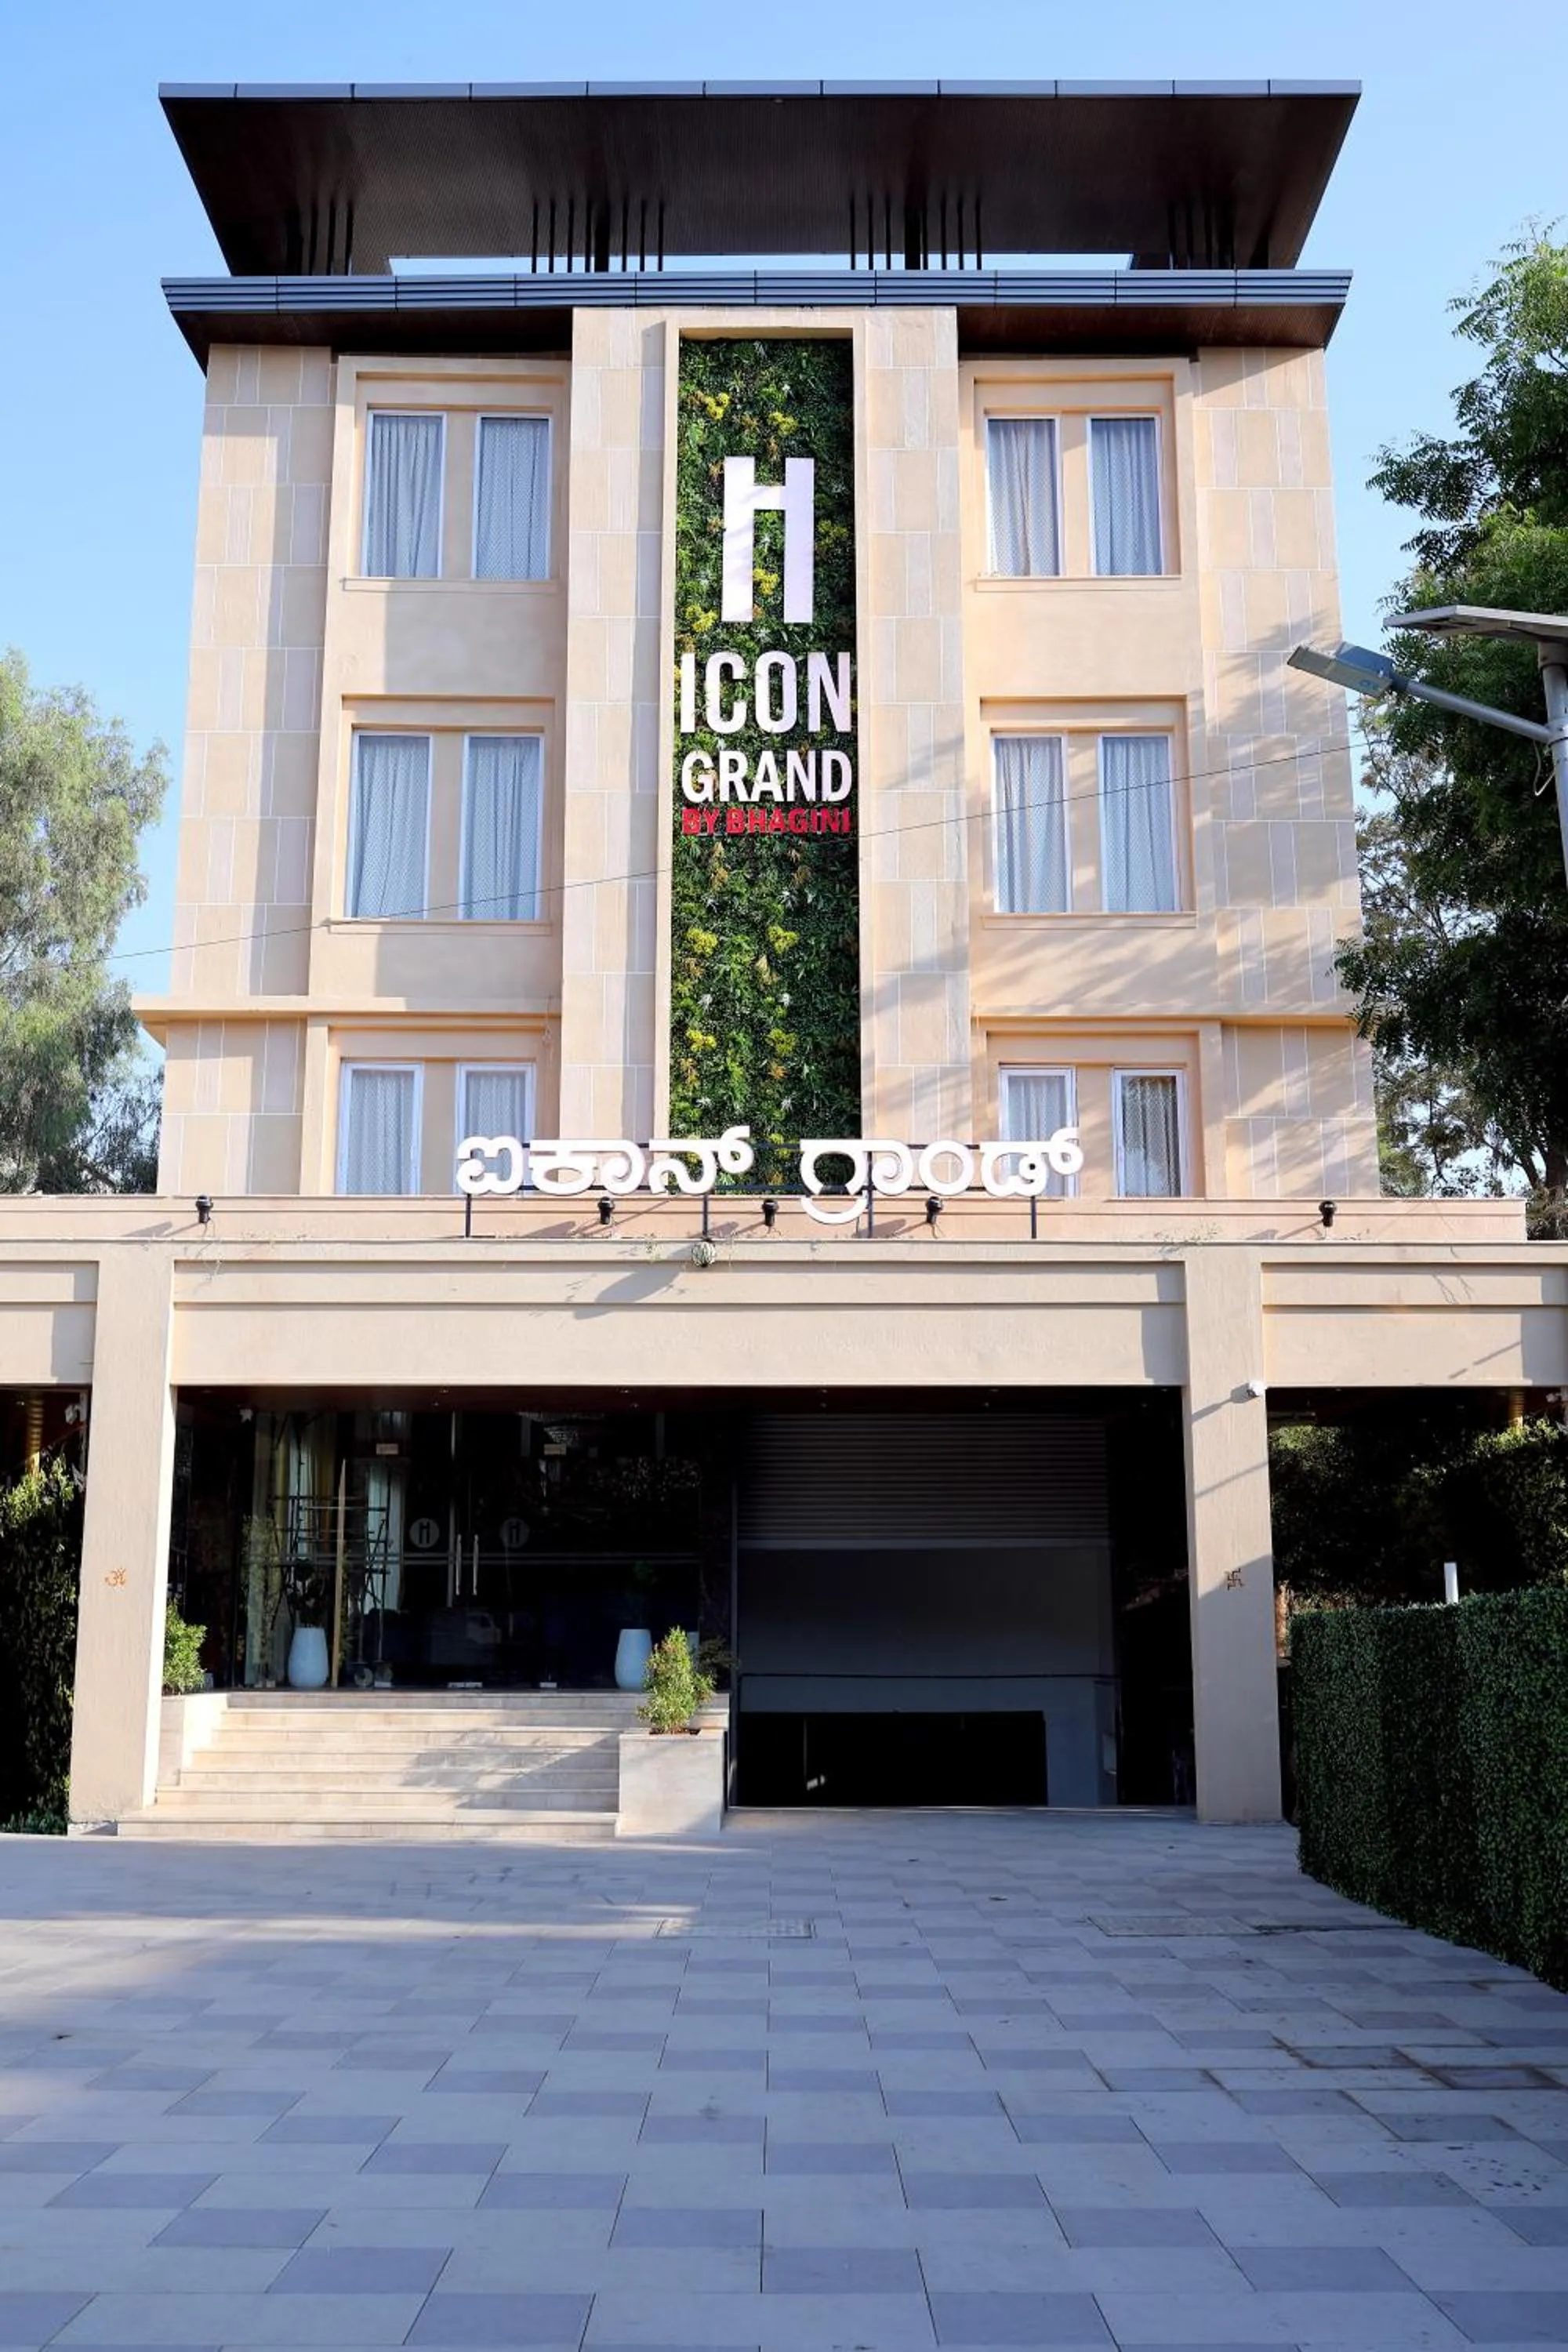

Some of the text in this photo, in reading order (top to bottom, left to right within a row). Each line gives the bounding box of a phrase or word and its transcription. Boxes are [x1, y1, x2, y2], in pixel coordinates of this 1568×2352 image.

[720, 456, 815, 624] H
[679, 651, 852, 734] ICON
[681, 750, 853, 804] GRAND
[682, 807, 851, 836] BY BHAGINI
[456, 1125, 754, 1196] ಐಕಾನ್
